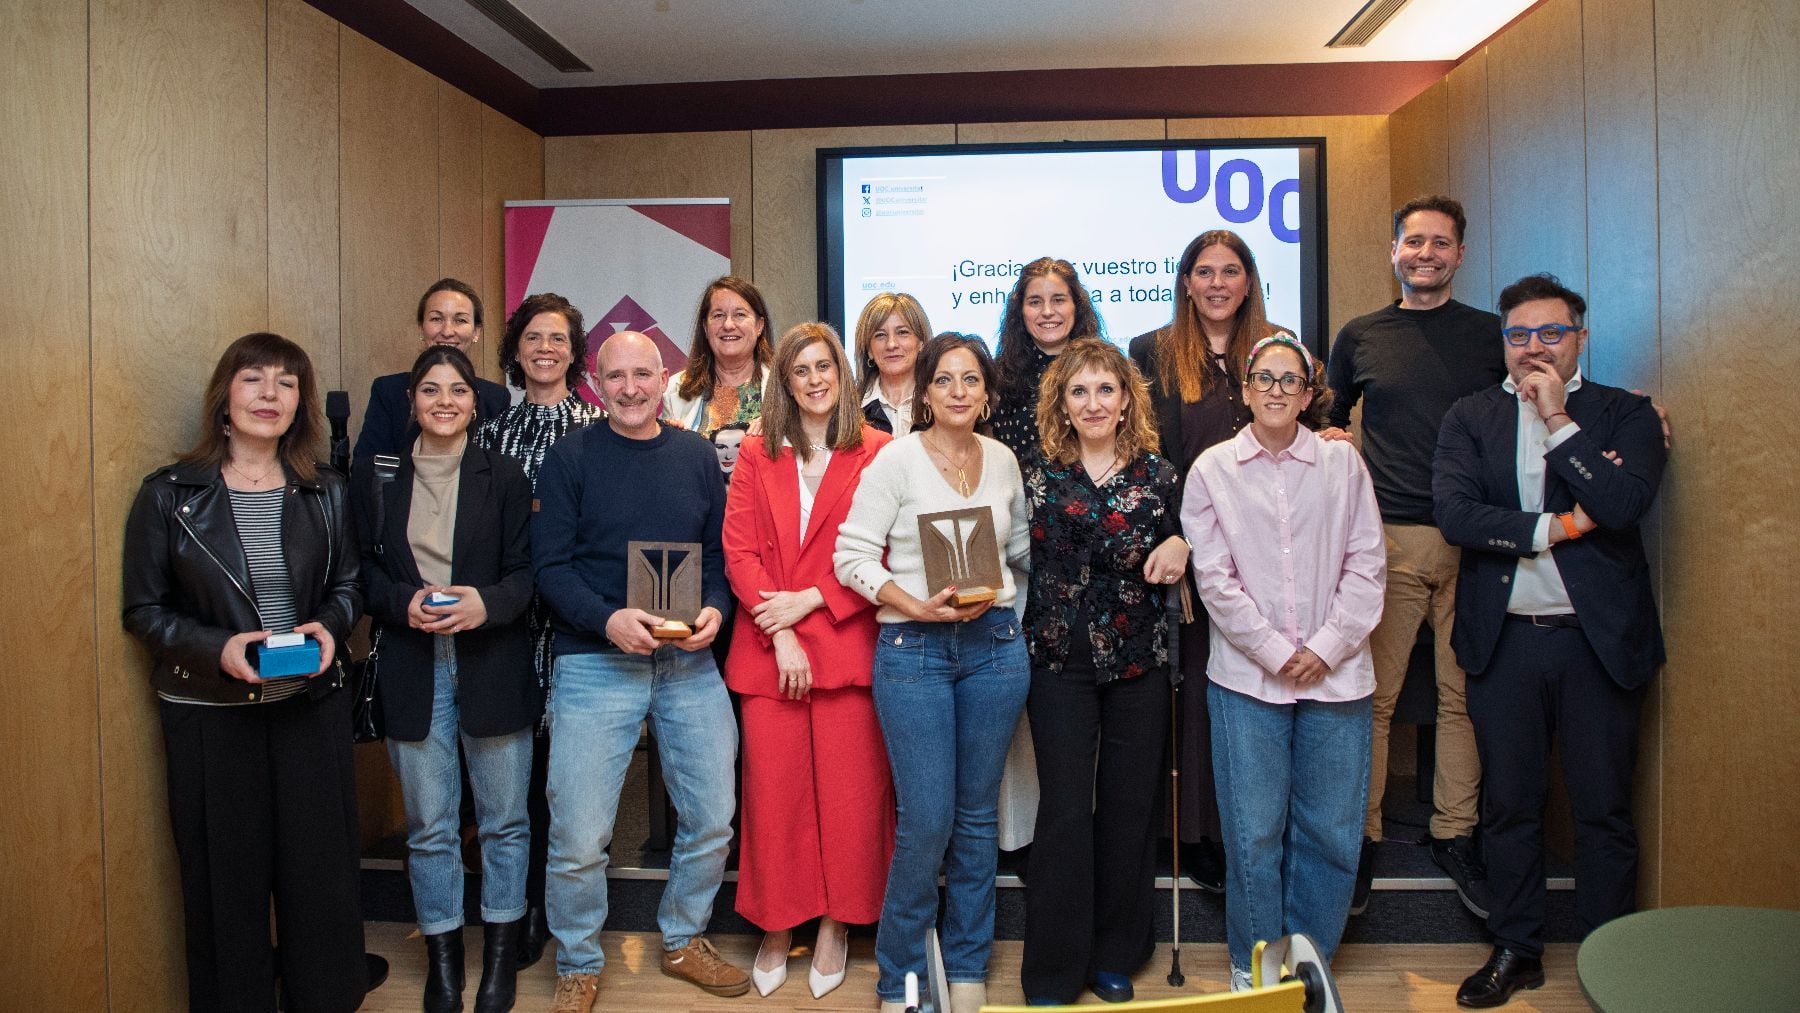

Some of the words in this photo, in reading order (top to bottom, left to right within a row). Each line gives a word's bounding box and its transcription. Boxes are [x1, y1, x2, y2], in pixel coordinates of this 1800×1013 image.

[1161, 149, 1301, 244] UOC
[953, 259, 1024, 282] ¡Gracia
[1083, 259, 1157, 276] vuestro
[952, 292, 963, 310] y
[1110, 289, 1122, 303] a
[1129, 284, 1173, 303] toda
